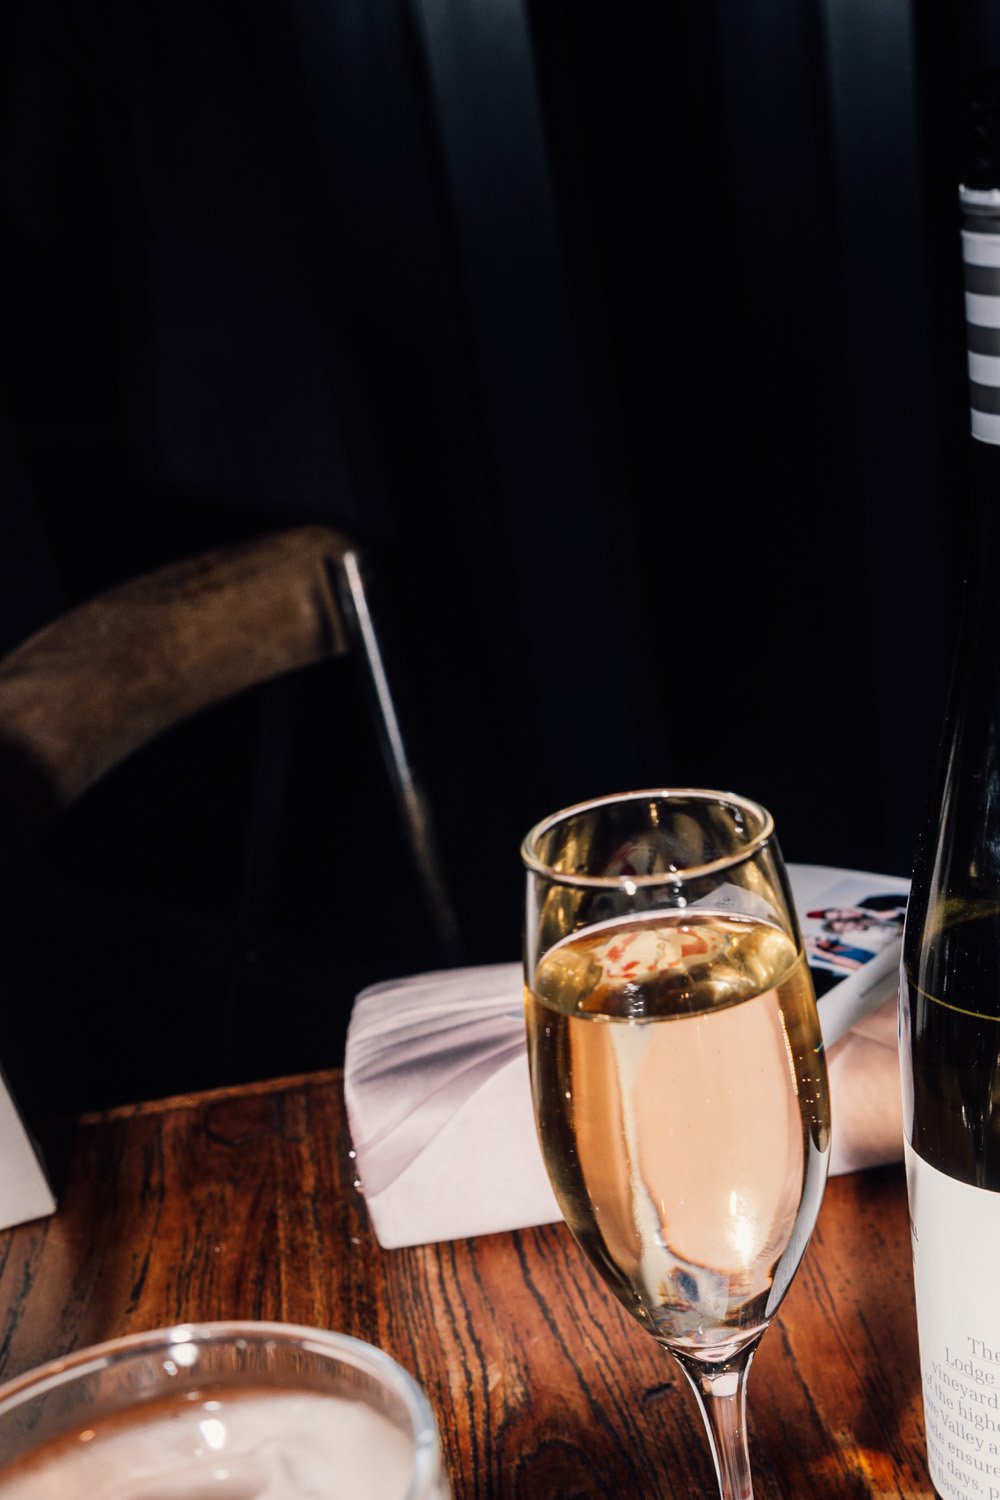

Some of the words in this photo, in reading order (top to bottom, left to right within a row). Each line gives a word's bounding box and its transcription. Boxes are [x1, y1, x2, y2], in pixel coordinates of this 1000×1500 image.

[930, 1360, 999, 1410] vineyard
[945, 1347, 995, 1386] Lodge
[934, 1384, 954, 1410] the
[940, 1409, 984, 1452] Valley
[947, 1460, 984, 1495] days,
